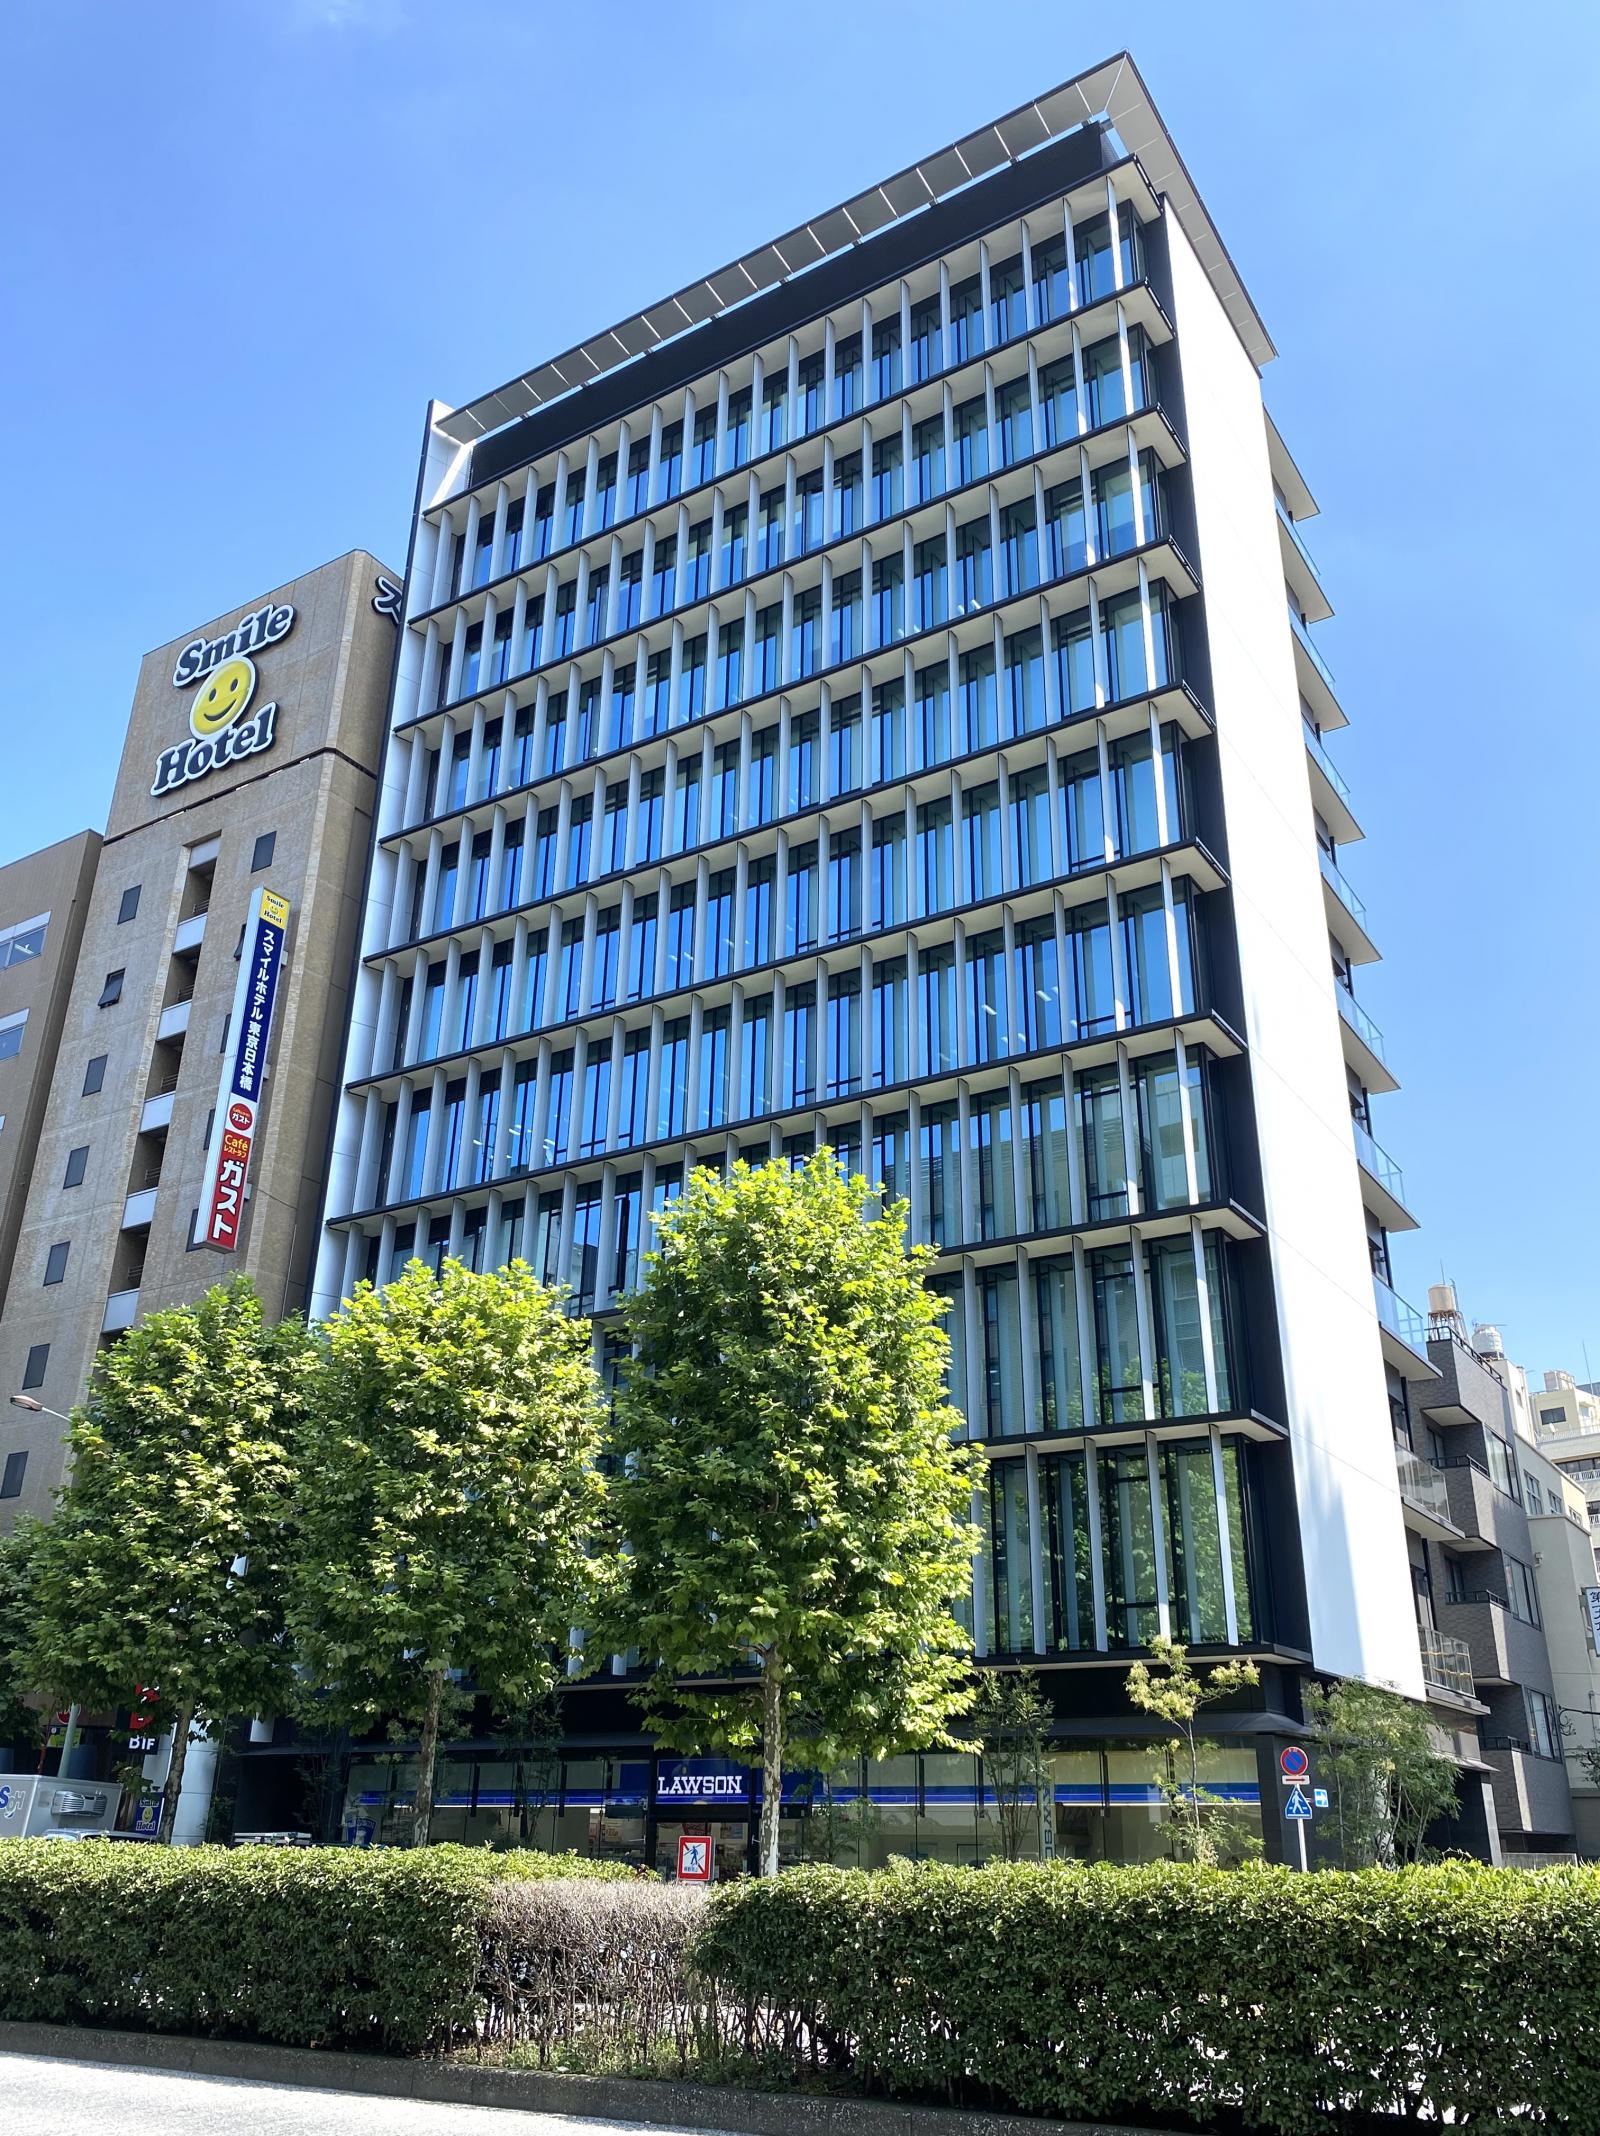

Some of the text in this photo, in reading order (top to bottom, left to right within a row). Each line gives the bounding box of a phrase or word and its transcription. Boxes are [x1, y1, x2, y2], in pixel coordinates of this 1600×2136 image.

[174, 603, 295, 686] Smile
[152, 702, 276, 794] Hotel
[266, 895, 285, 909] Smile
[263, 909, 282, 924] Hotel
[239, 929, 275, 1092] スマイルホテル東京日本橋
[232, 1112, 250, 1125] ガスト
[223, 1144, 247, 1158] レストラン
[224, 1134, 249, 1151] Café
[211, 1159, 245, 1240] ガスト
[657, 1775, 743, 1795] LAWSON
[135, 1821, 156, 1832] Hotel
